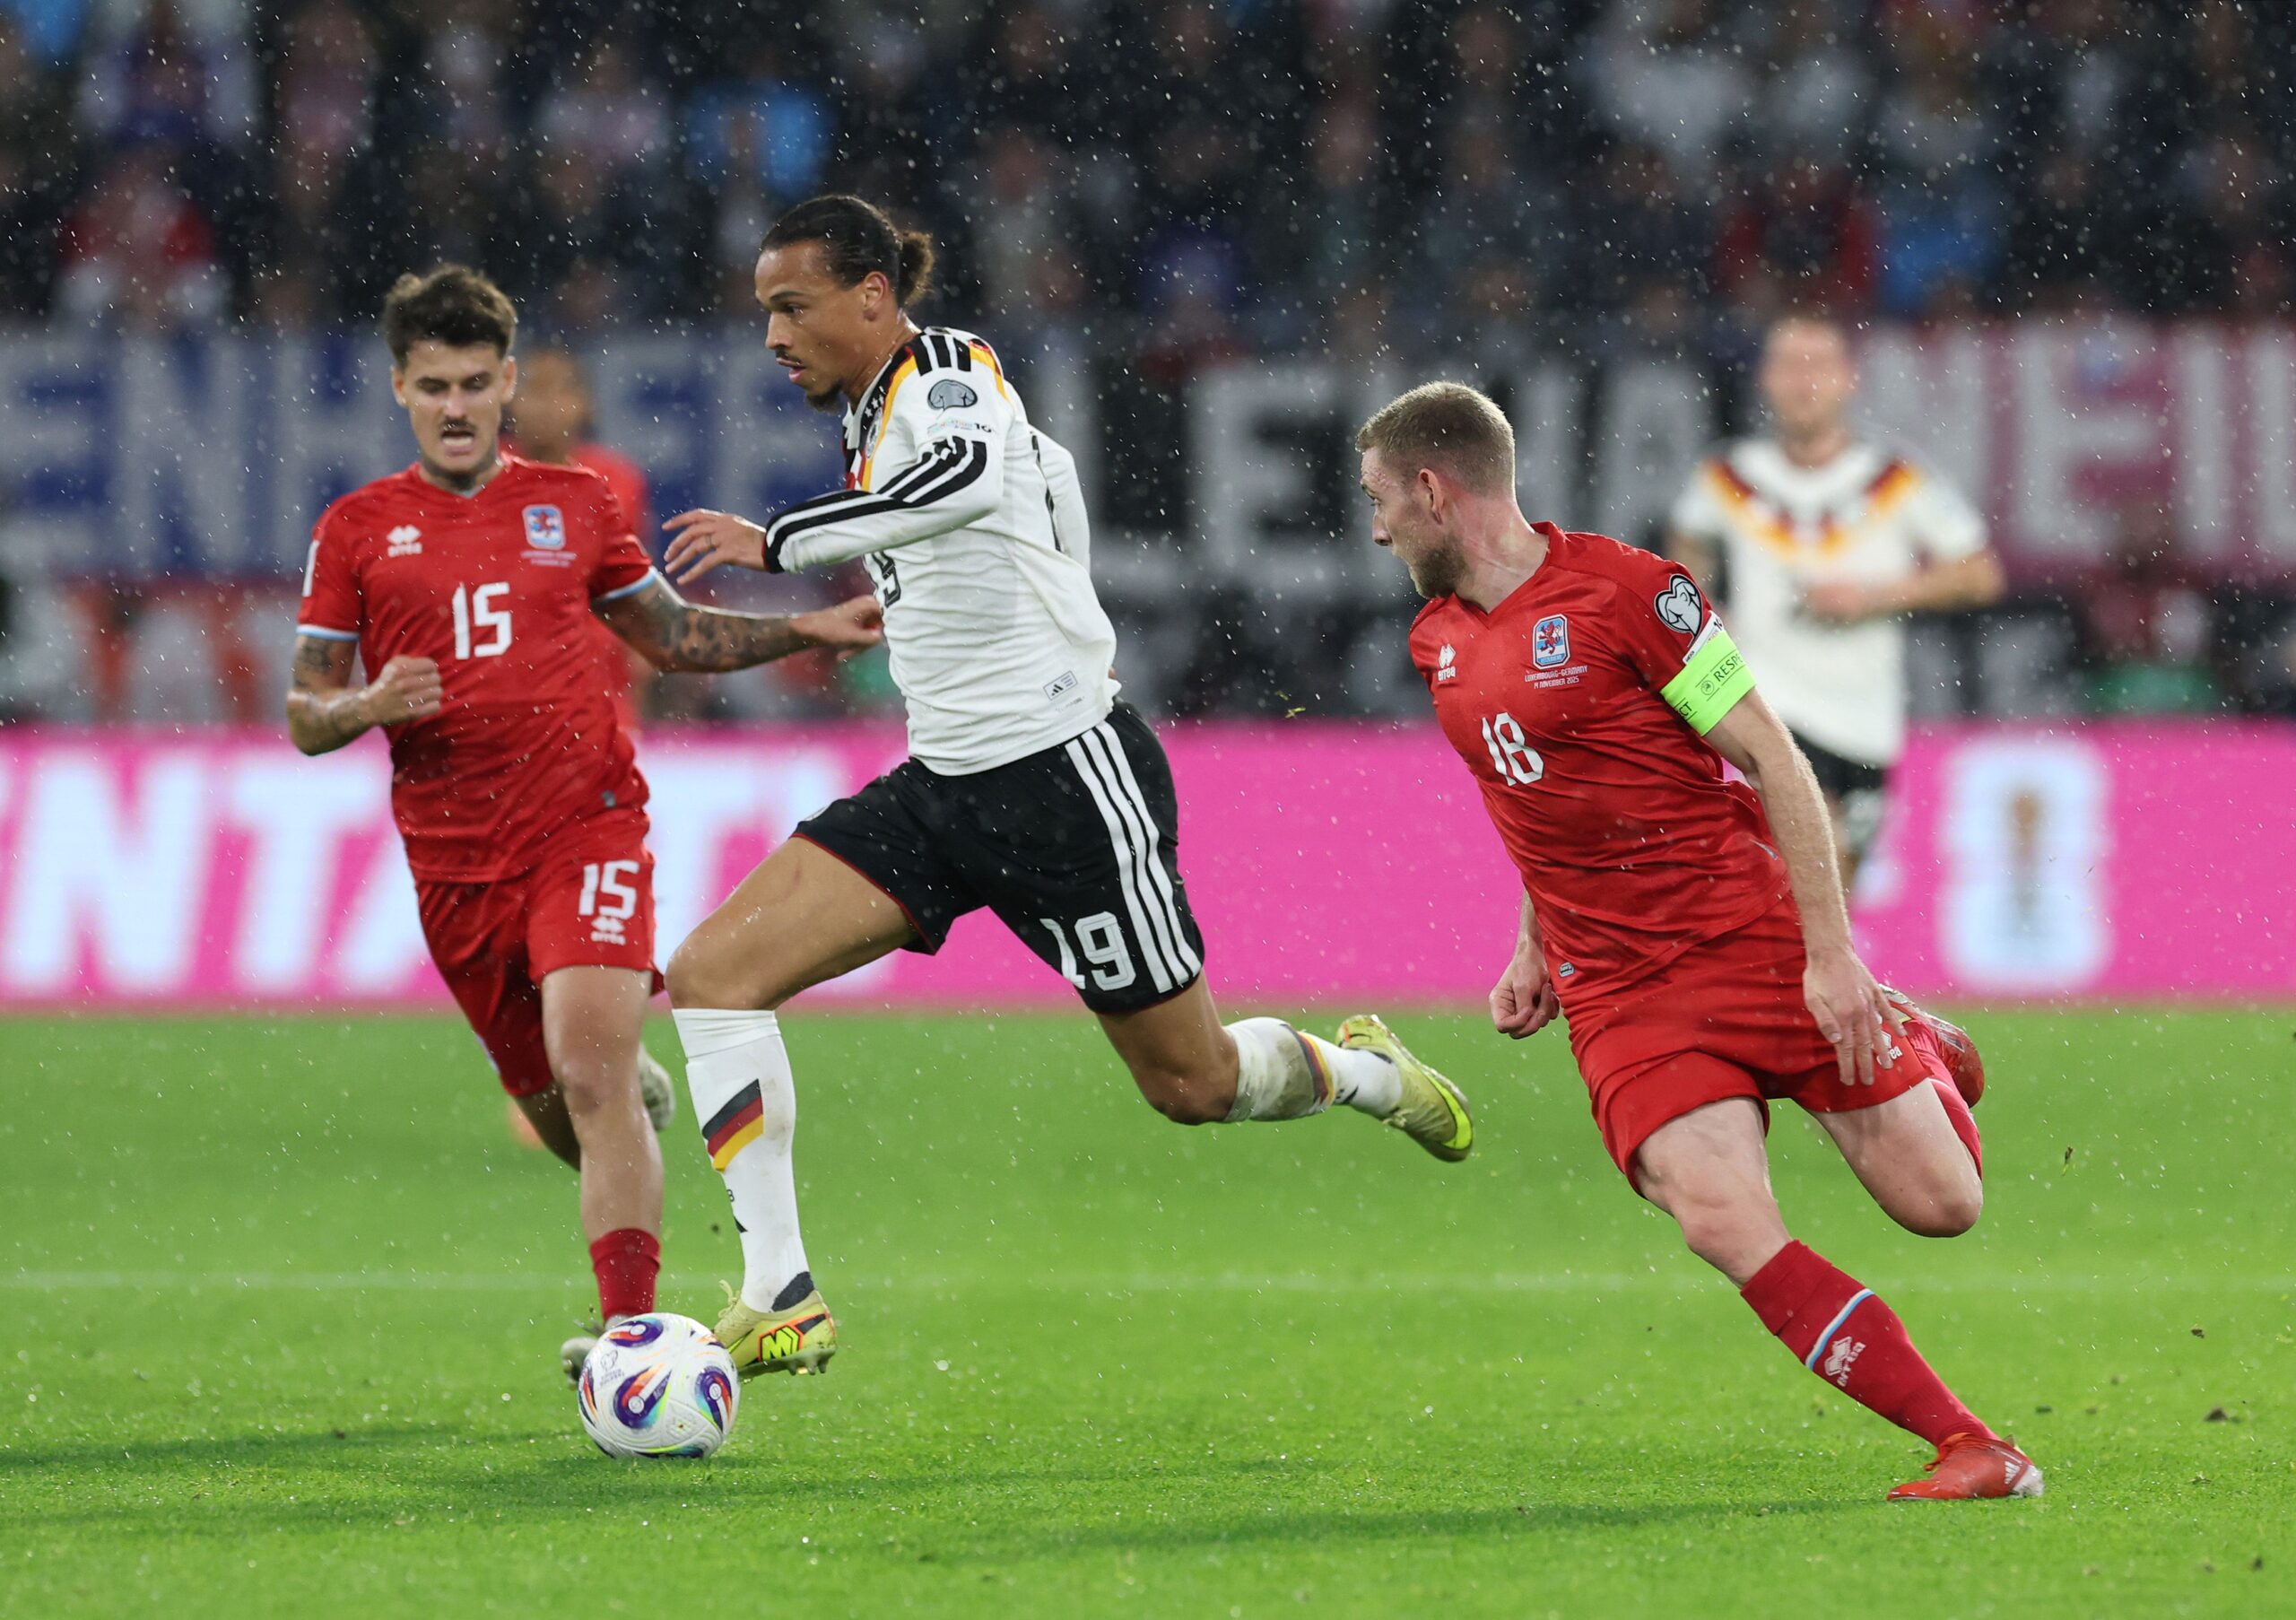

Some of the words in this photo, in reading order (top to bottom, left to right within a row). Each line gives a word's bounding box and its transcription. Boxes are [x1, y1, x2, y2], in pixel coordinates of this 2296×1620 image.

[452, 580, 512, 660] 15
[1539, 677, 1565, 689] NOVEMBER
[1482, 711, 1544, 787] 18
[578, 859, 639, 920] 15
[1039, 910, 1137, 991] 19
